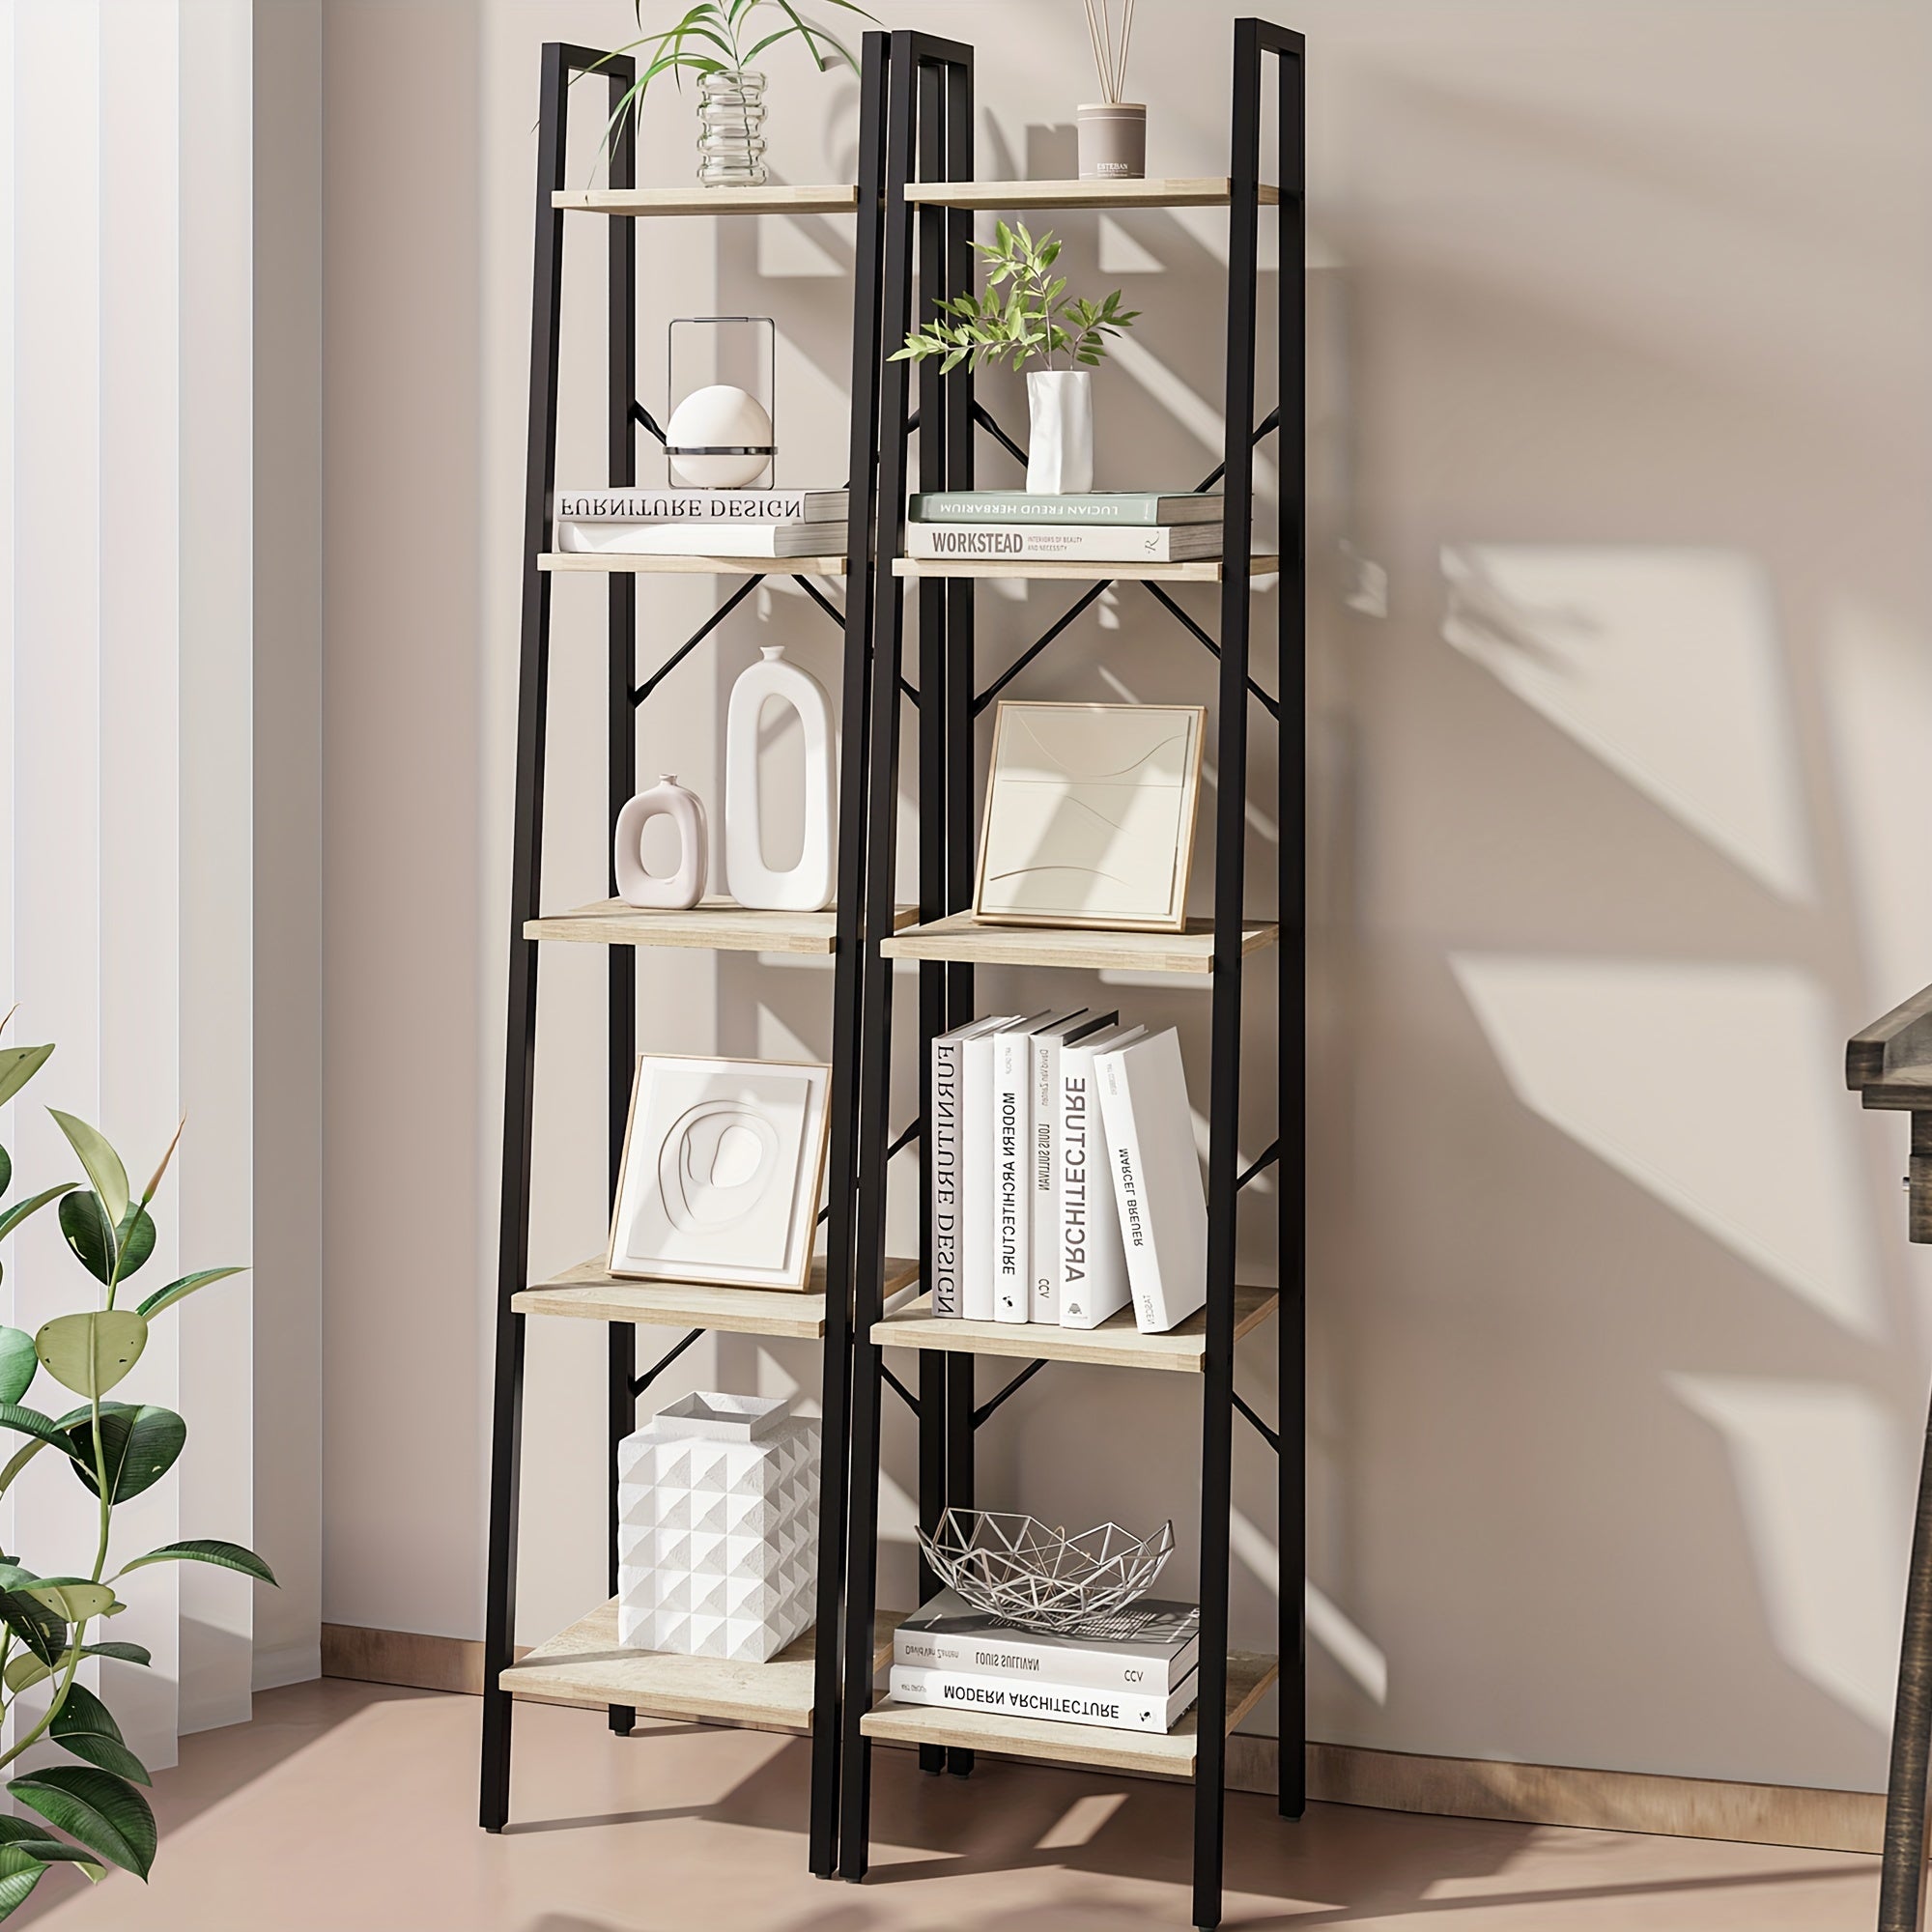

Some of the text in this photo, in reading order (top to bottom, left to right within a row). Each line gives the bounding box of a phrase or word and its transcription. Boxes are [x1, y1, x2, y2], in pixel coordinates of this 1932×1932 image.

[940, 503, 1119, 516] LUCIAN FREUD HERBARIUM
[932, 531, 1024, 554] WORKSTEAD
